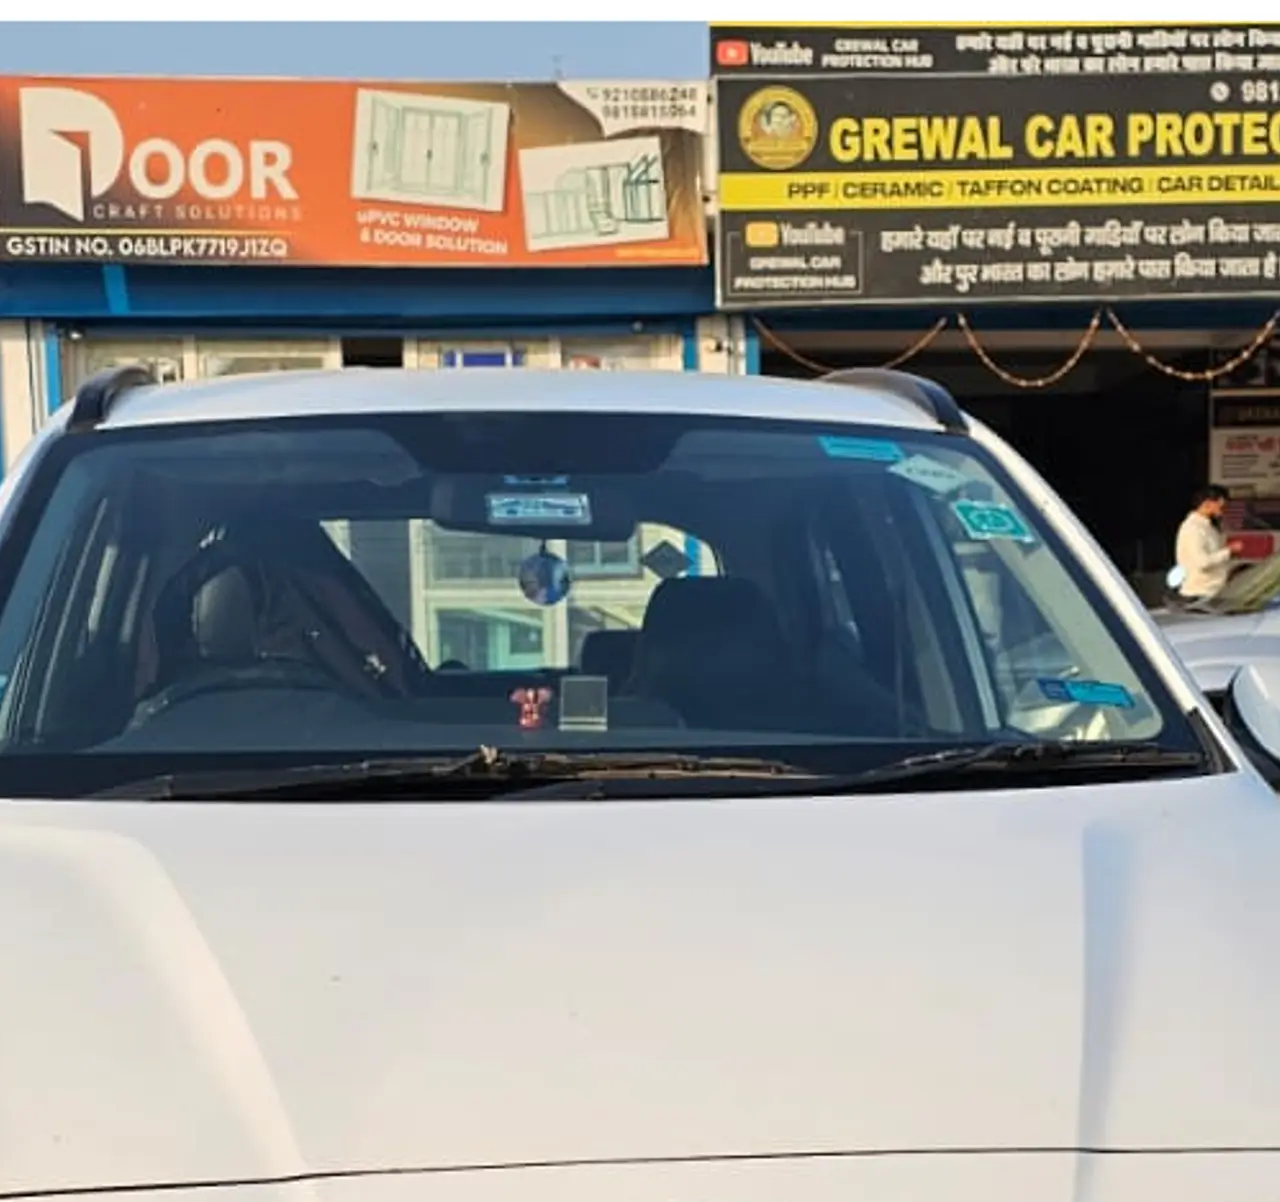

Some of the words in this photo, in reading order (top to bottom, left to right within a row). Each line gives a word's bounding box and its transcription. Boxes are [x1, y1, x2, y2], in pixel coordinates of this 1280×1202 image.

[751, 40, 813, 66] YouTube
[891, 38, 919, 53] CAR
[822, 54, 903, 68] PROTECTION
[905, 53, 934, 68] HUB
[829, 115, 1014, 163] GREWAL
[1024, 113, 1116, 160] CAR
[20, 87, 300, 222] DOOR
[787, 181, 831, 199] PPF
[842, 179, 944, 199] CERAMIC
[957, 178, 1042, 198] TAFFON
[1046, 176, 1144, 196] COATING
[1156, 176, 1204, 194] CAR
[92, 204, 165, 221] CRAFT
[175, 204, 303, 222] SOLUTIONS
[355, 208, 402, 226] uPVC
[403, 212, 480, 233] WINDOW
[374, 230, 423, 247] DOOR
[424, 235, 509, 255] SOLUTION
[780, 221, 846, 247] YouTube
[6, 235, 70, 256] GSTIN
[75, 236, 114, 257] NO.
[810, 256, 842, 270] CAR
[733, 275, 824, 290] PROTECTION
[825, 274, 857, 289] HUB
